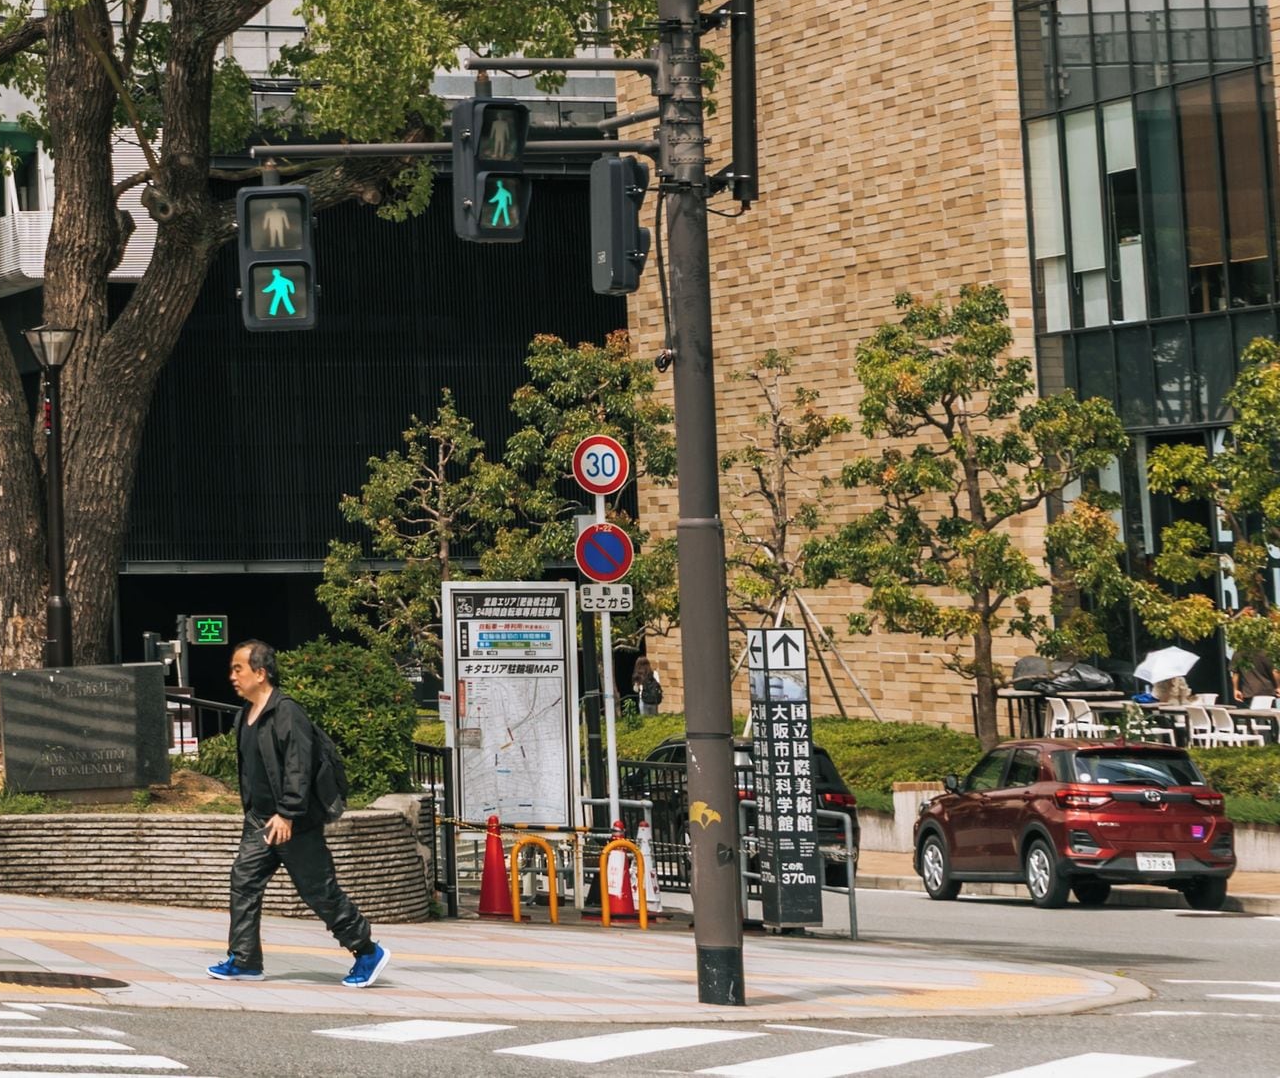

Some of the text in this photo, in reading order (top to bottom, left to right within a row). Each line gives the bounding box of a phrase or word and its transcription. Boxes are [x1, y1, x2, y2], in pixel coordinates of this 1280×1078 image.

[585, 452, 616, 478] 30
[583, 586, 631, 596] 自動車
[583, 597, 631, 610] ここから
[197, 618, 223, 642] 空
[771, 704, 794, 833] 大阪市立科学館
[790, 703, 814, 832] 国立国際美術館
[781, 872, 816, 885] 370m
